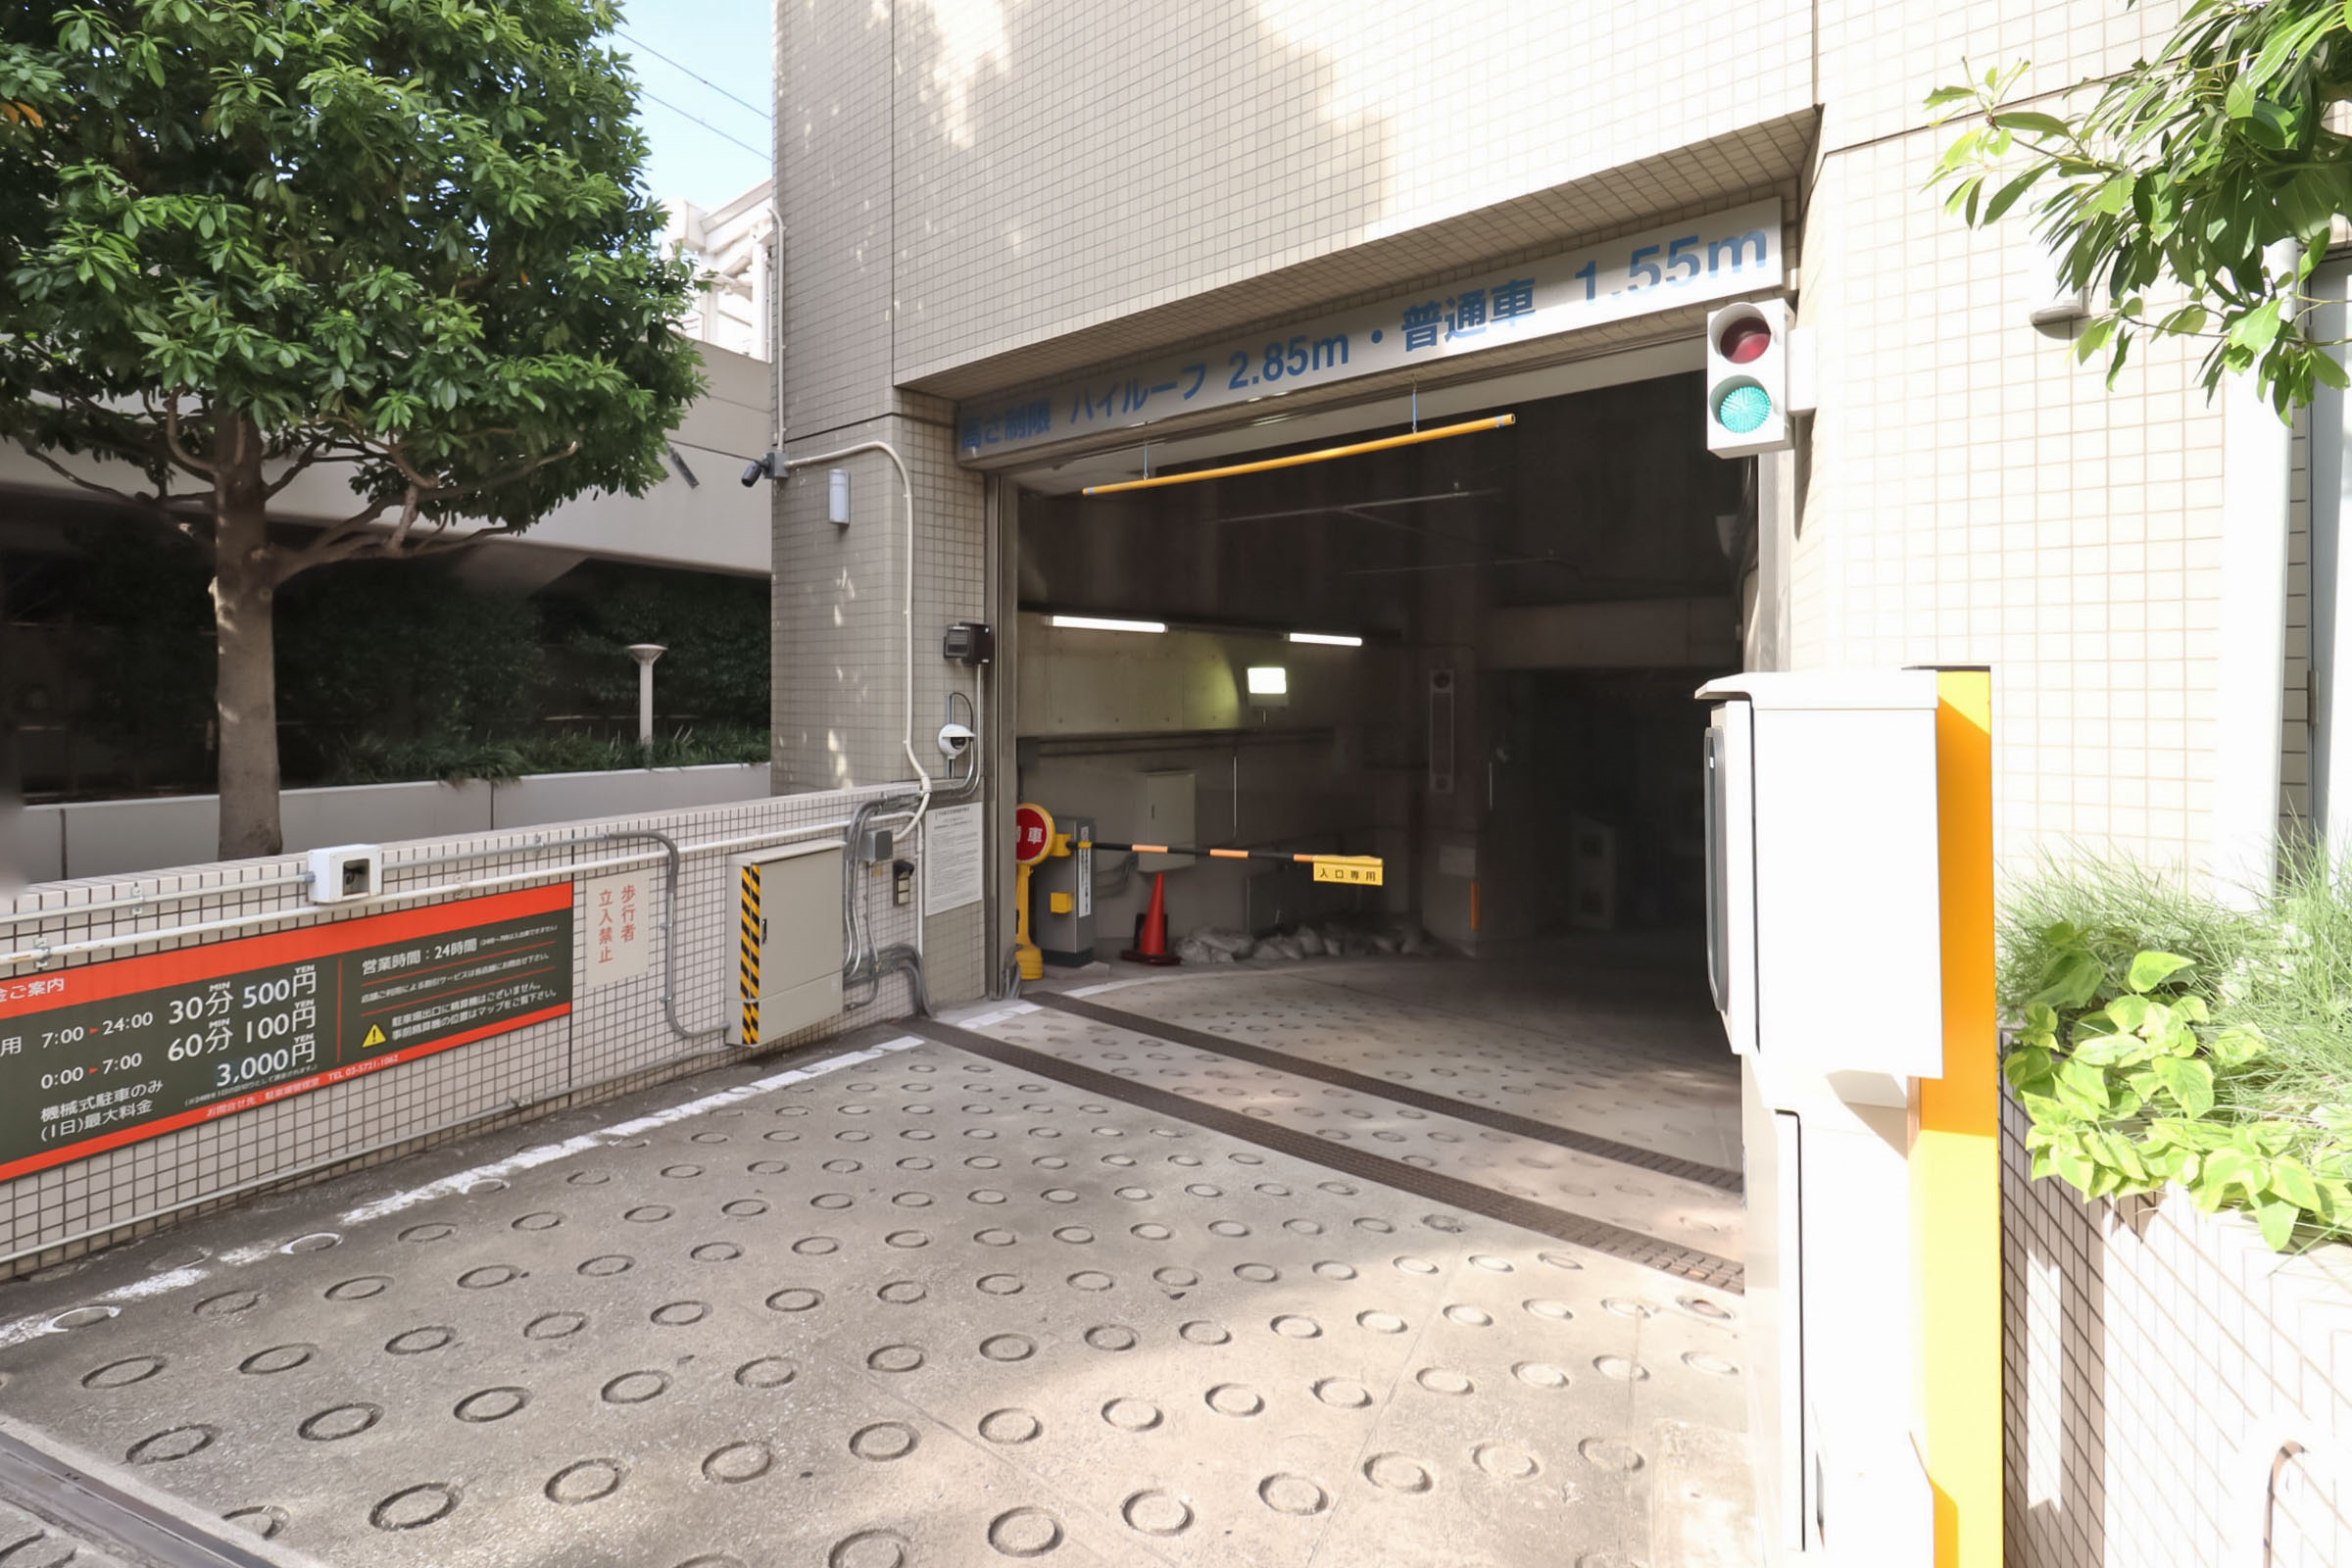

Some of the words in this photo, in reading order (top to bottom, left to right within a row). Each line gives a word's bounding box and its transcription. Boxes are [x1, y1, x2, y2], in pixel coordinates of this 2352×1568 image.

[1069, 362, 1206, 424] ハイルーフ
[1574, 227, 1768, 306] 1.55m
[1319, 867, 1377, 882] 入口専用
[598, 888, 613, 964] 立入禁止
[620, 883, 636, 943] 歩行者
[209, 981, 230, 993] MIN
[295, 964, 315, 974] YEN
[242, 971, 317, 1009] 500円
[294, 999, 315, 1009] YEN
[209, 1017, 230, 1029] MIN
[246, 1005, 317, 1044] 100円
[216, 1040, 316, 1088] 3,000円
[40, 1079, 164, 1123] 機械式駐車のみ
